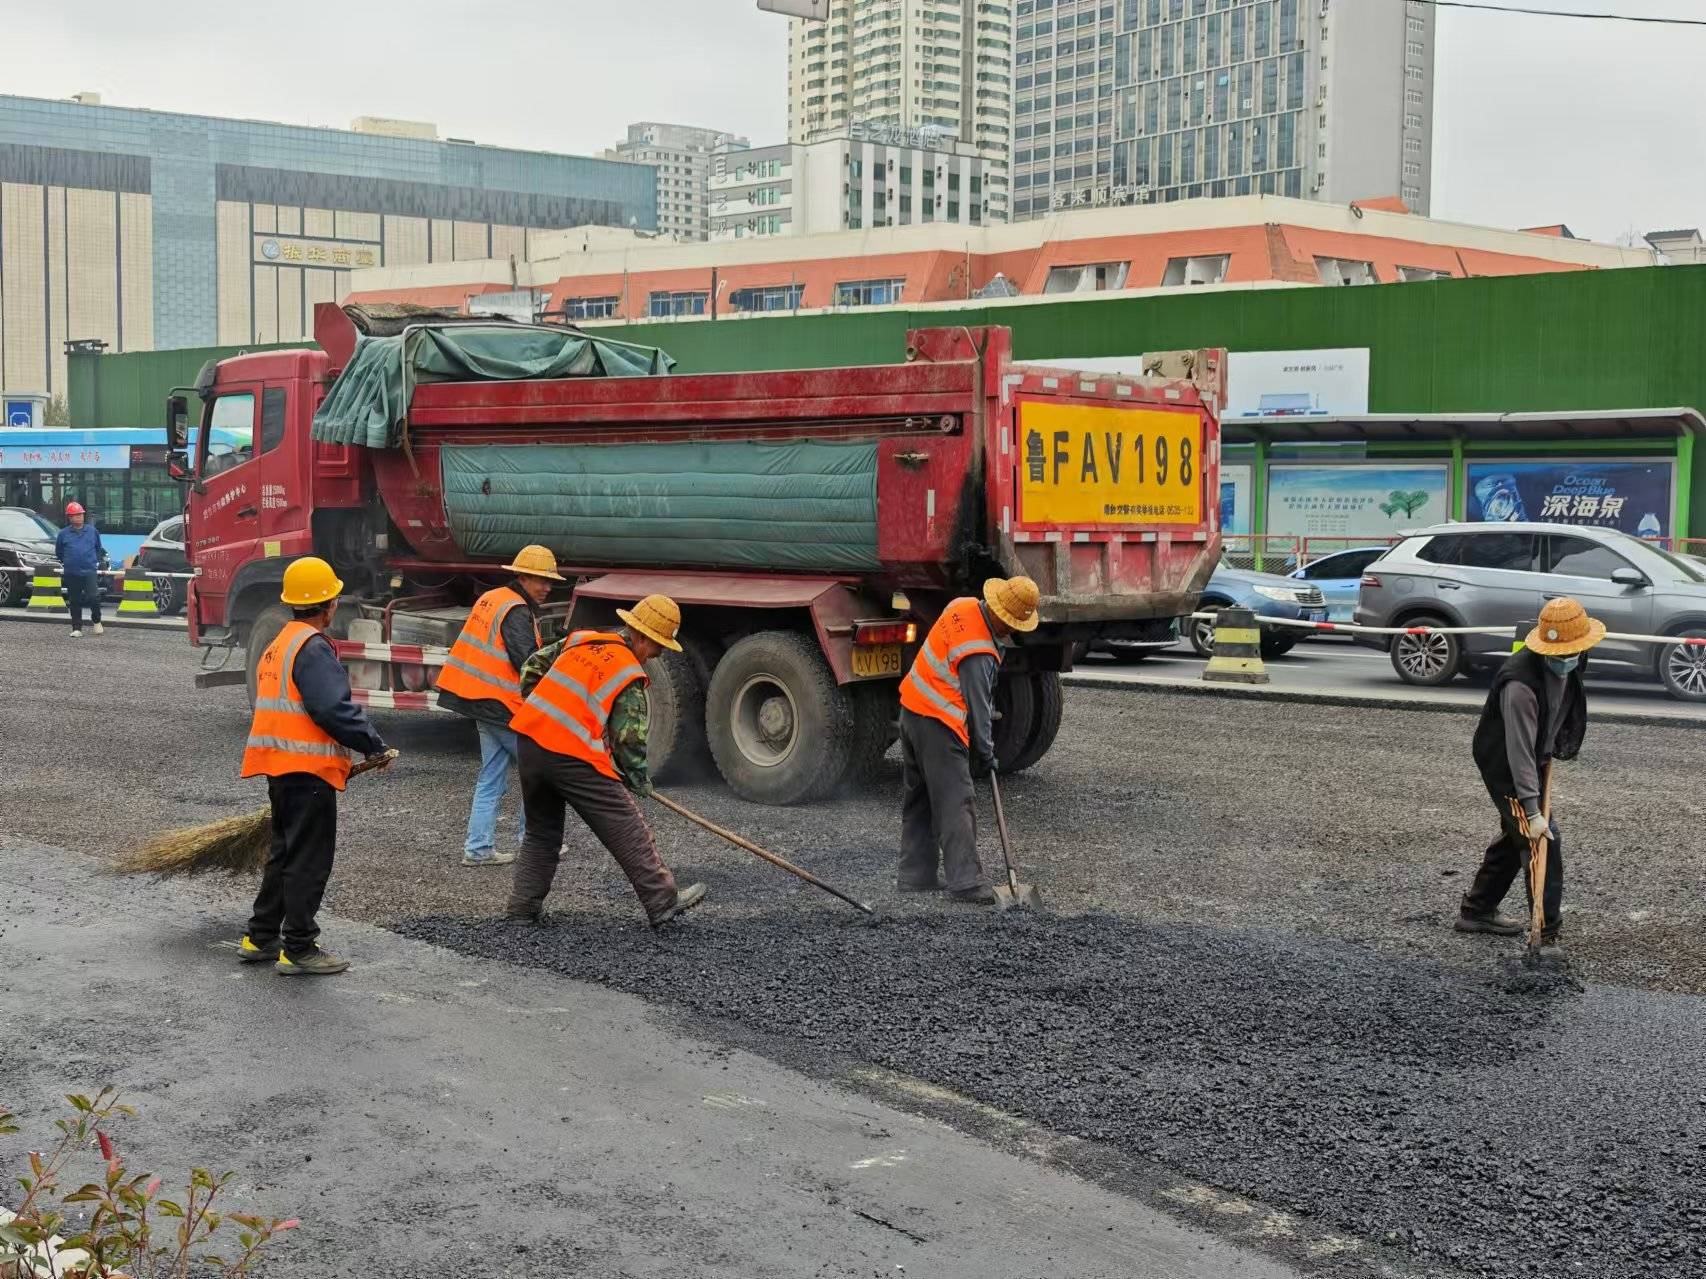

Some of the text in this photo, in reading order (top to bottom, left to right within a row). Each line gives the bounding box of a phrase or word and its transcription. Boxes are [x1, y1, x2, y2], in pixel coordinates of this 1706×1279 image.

[282, 243, 375, 265] 振华商厦
[1026, 428, 1193, 486] 鲁FAV198
[1552, 485, 1617, 495] Deep Blue
[1563, 475, 1607, 485] Ocean
[1539, 494, 1624, 519] 深海泉
